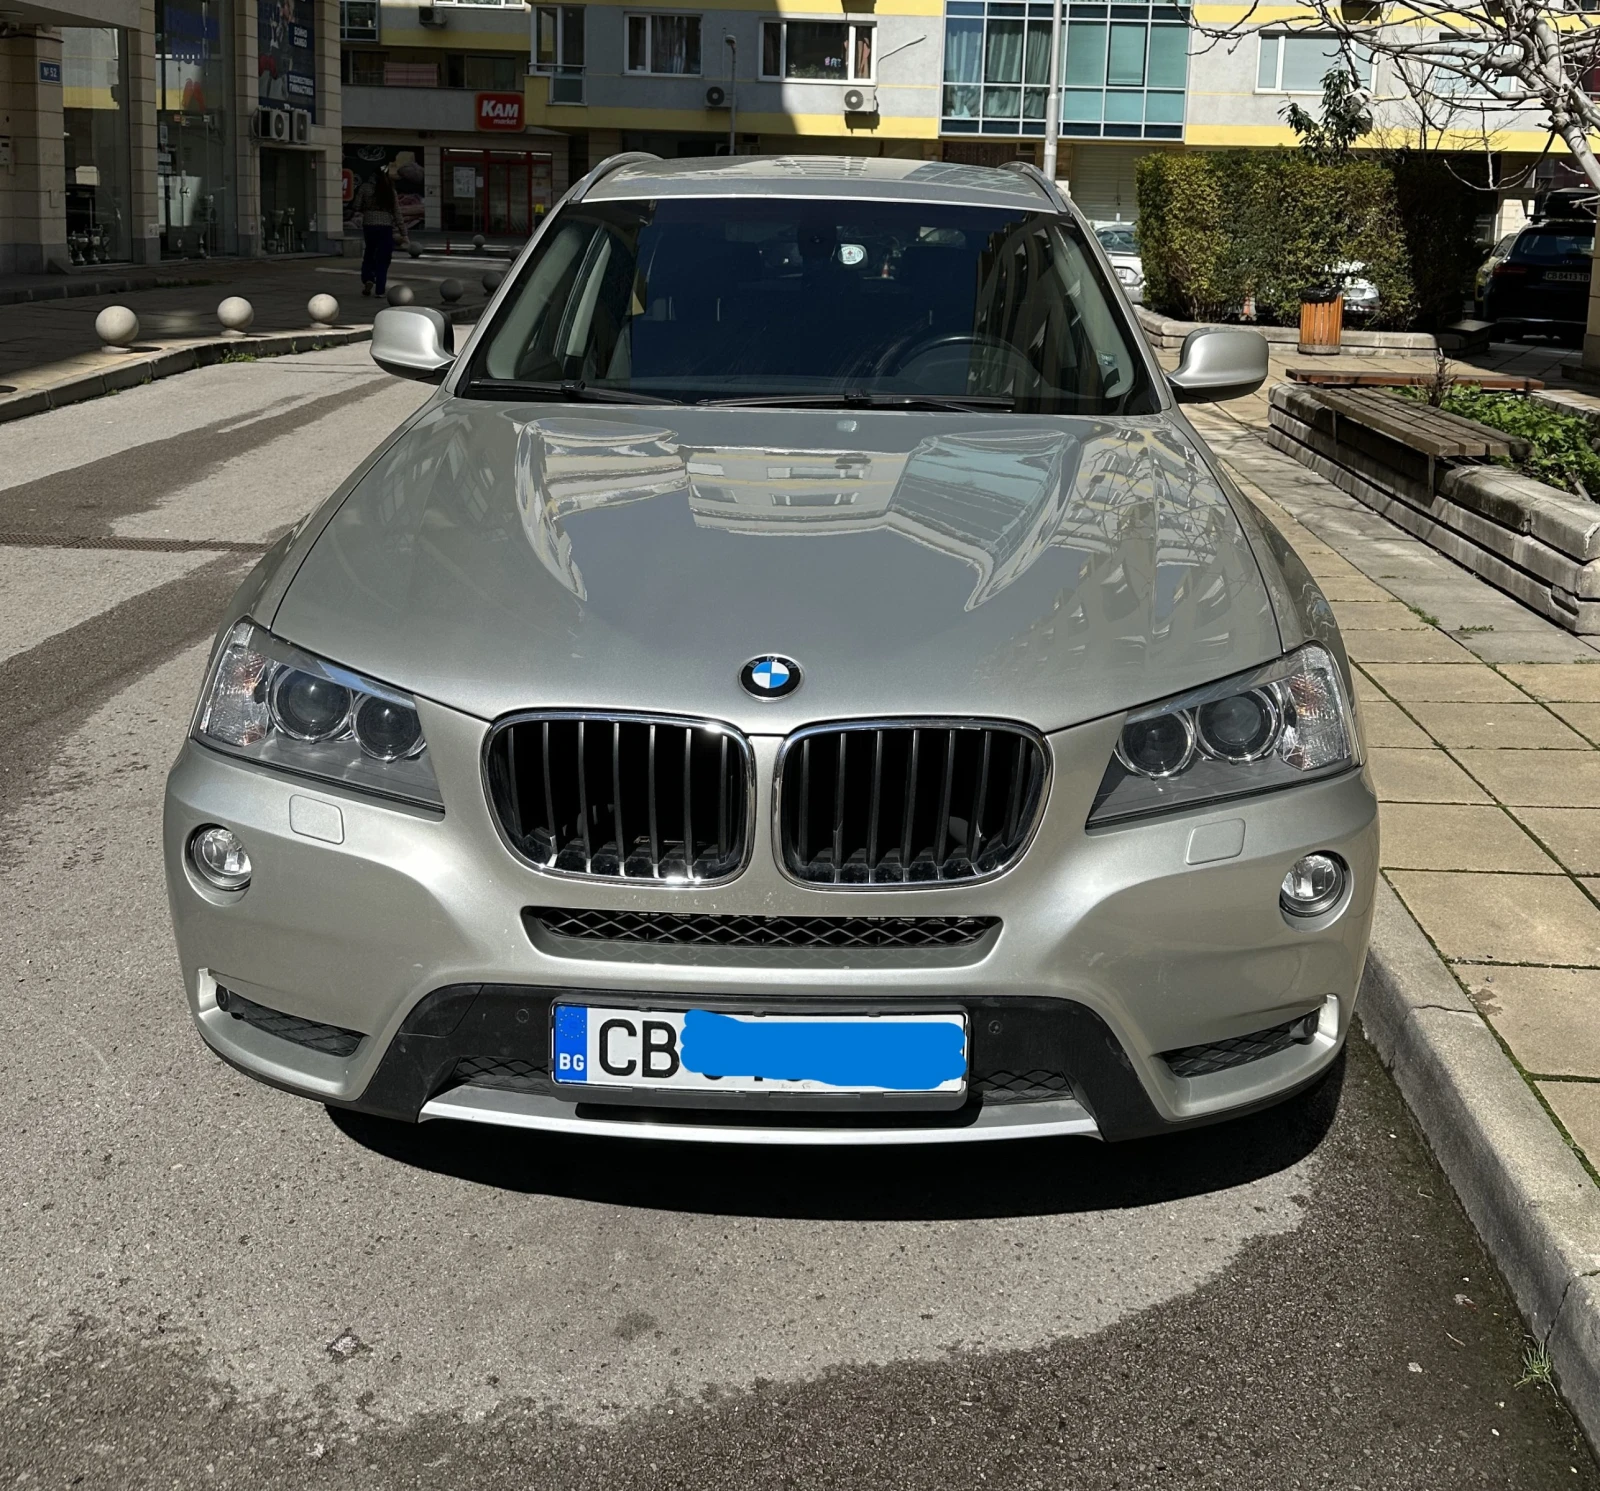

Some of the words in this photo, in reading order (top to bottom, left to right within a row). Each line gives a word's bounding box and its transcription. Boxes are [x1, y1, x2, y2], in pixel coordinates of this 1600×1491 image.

[50, 67, 58, 78] 52
[481, 100, 519, 118] KAM
[598, 1018, 681, 1079] CB
[559, 1053, 585, 1072] BG
